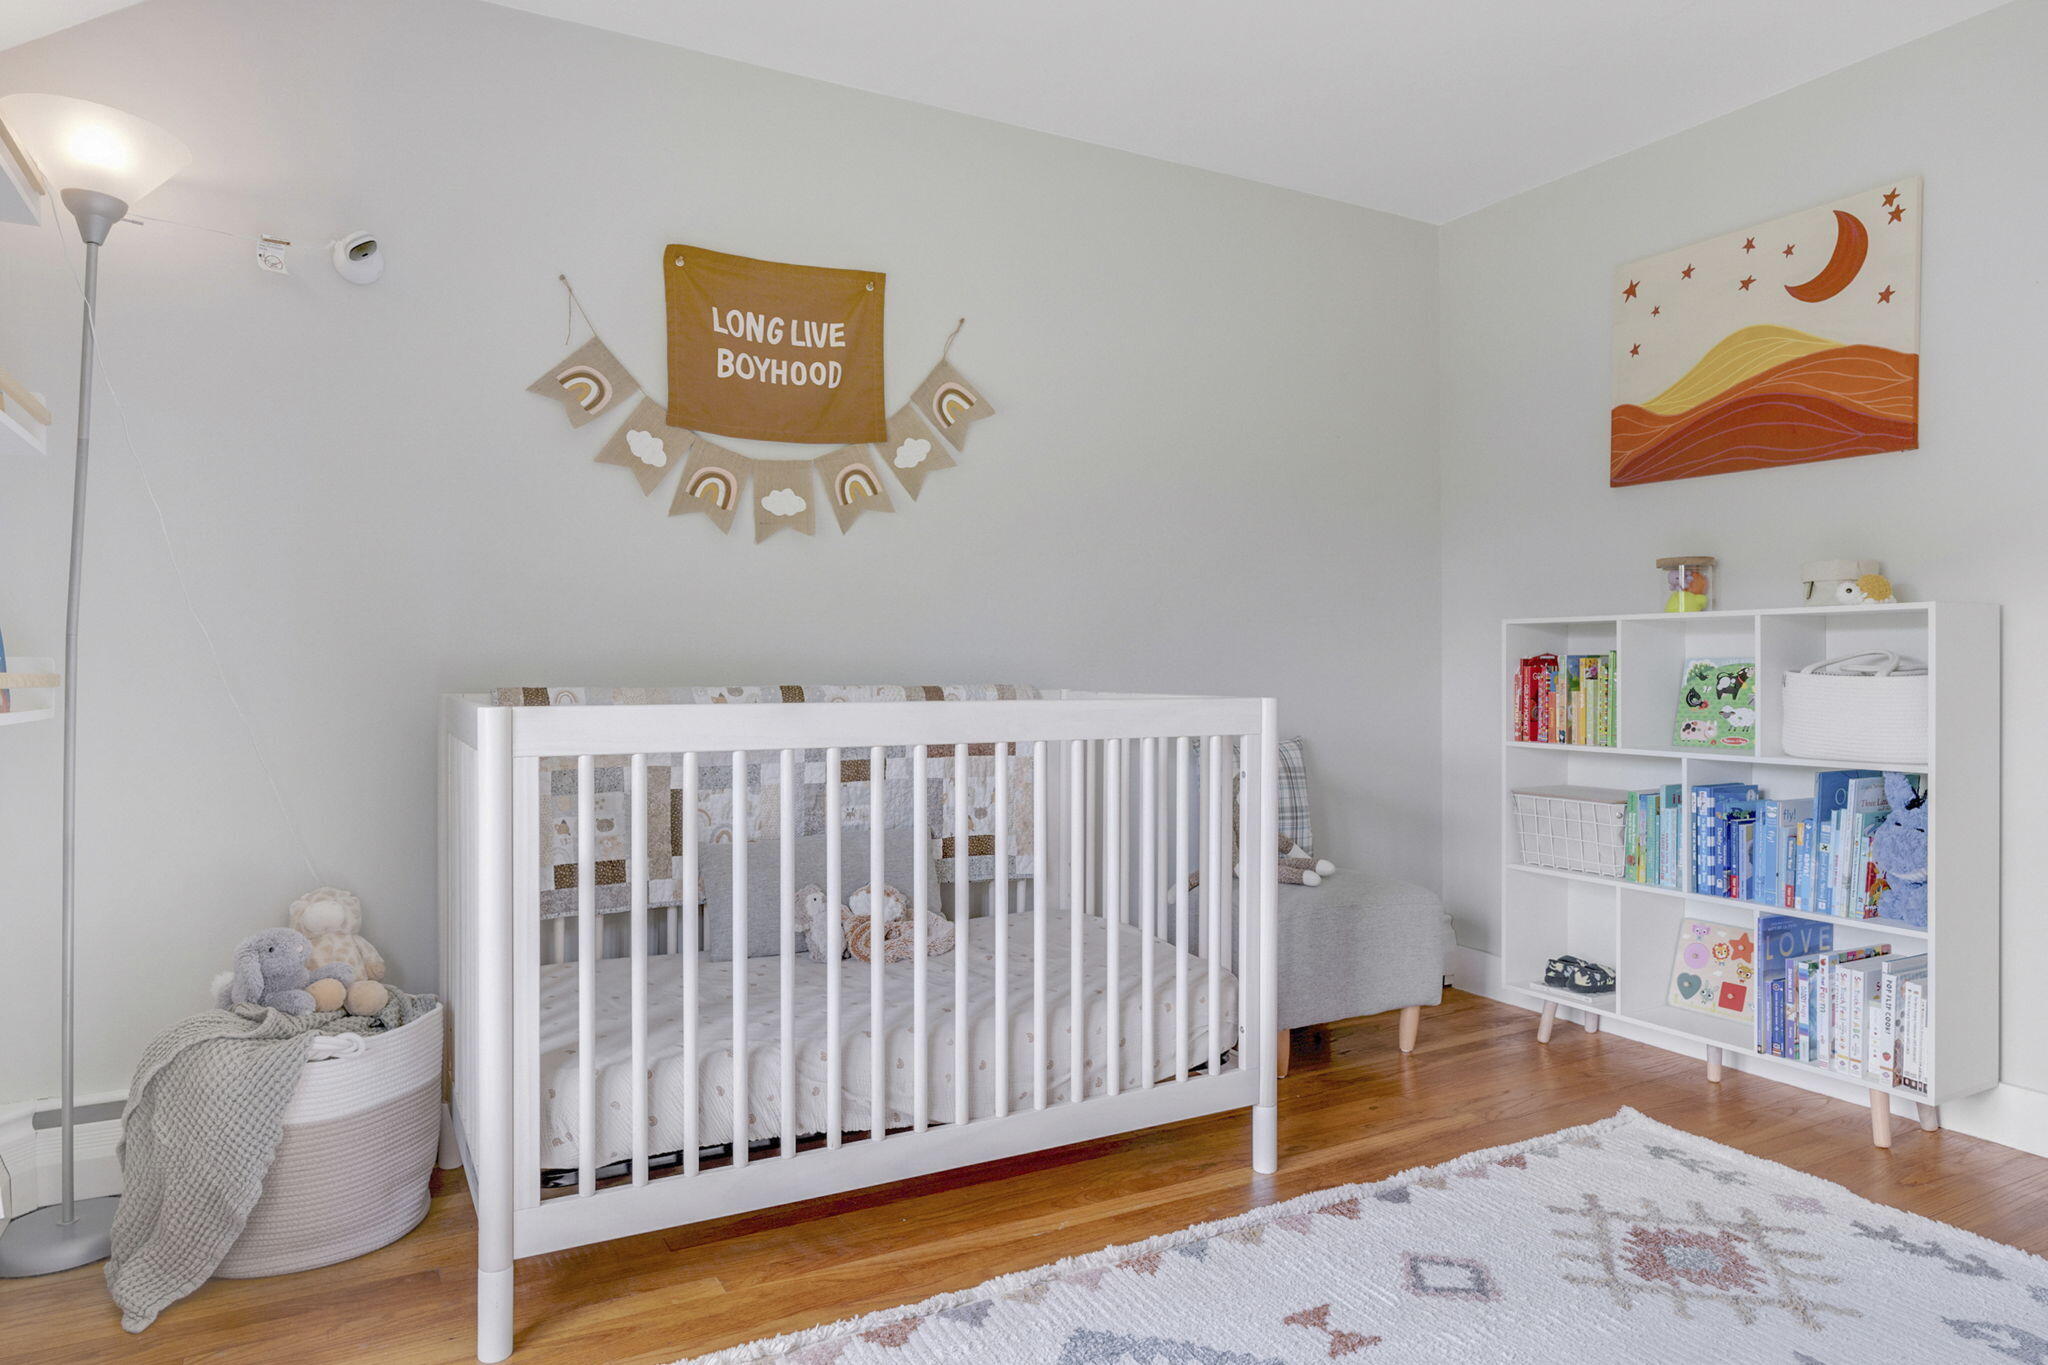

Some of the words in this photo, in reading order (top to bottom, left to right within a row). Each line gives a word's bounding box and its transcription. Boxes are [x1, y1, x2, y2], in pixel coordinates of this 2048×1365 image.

[712, 306, 785, 344] LONG
[791, 319, 846, 348] LIVE
[717, 348, 842, 389] BOYHOOD
[1783, 806, 1797, 823] fly!
[1766, 926, 1831, 960] LOVE
